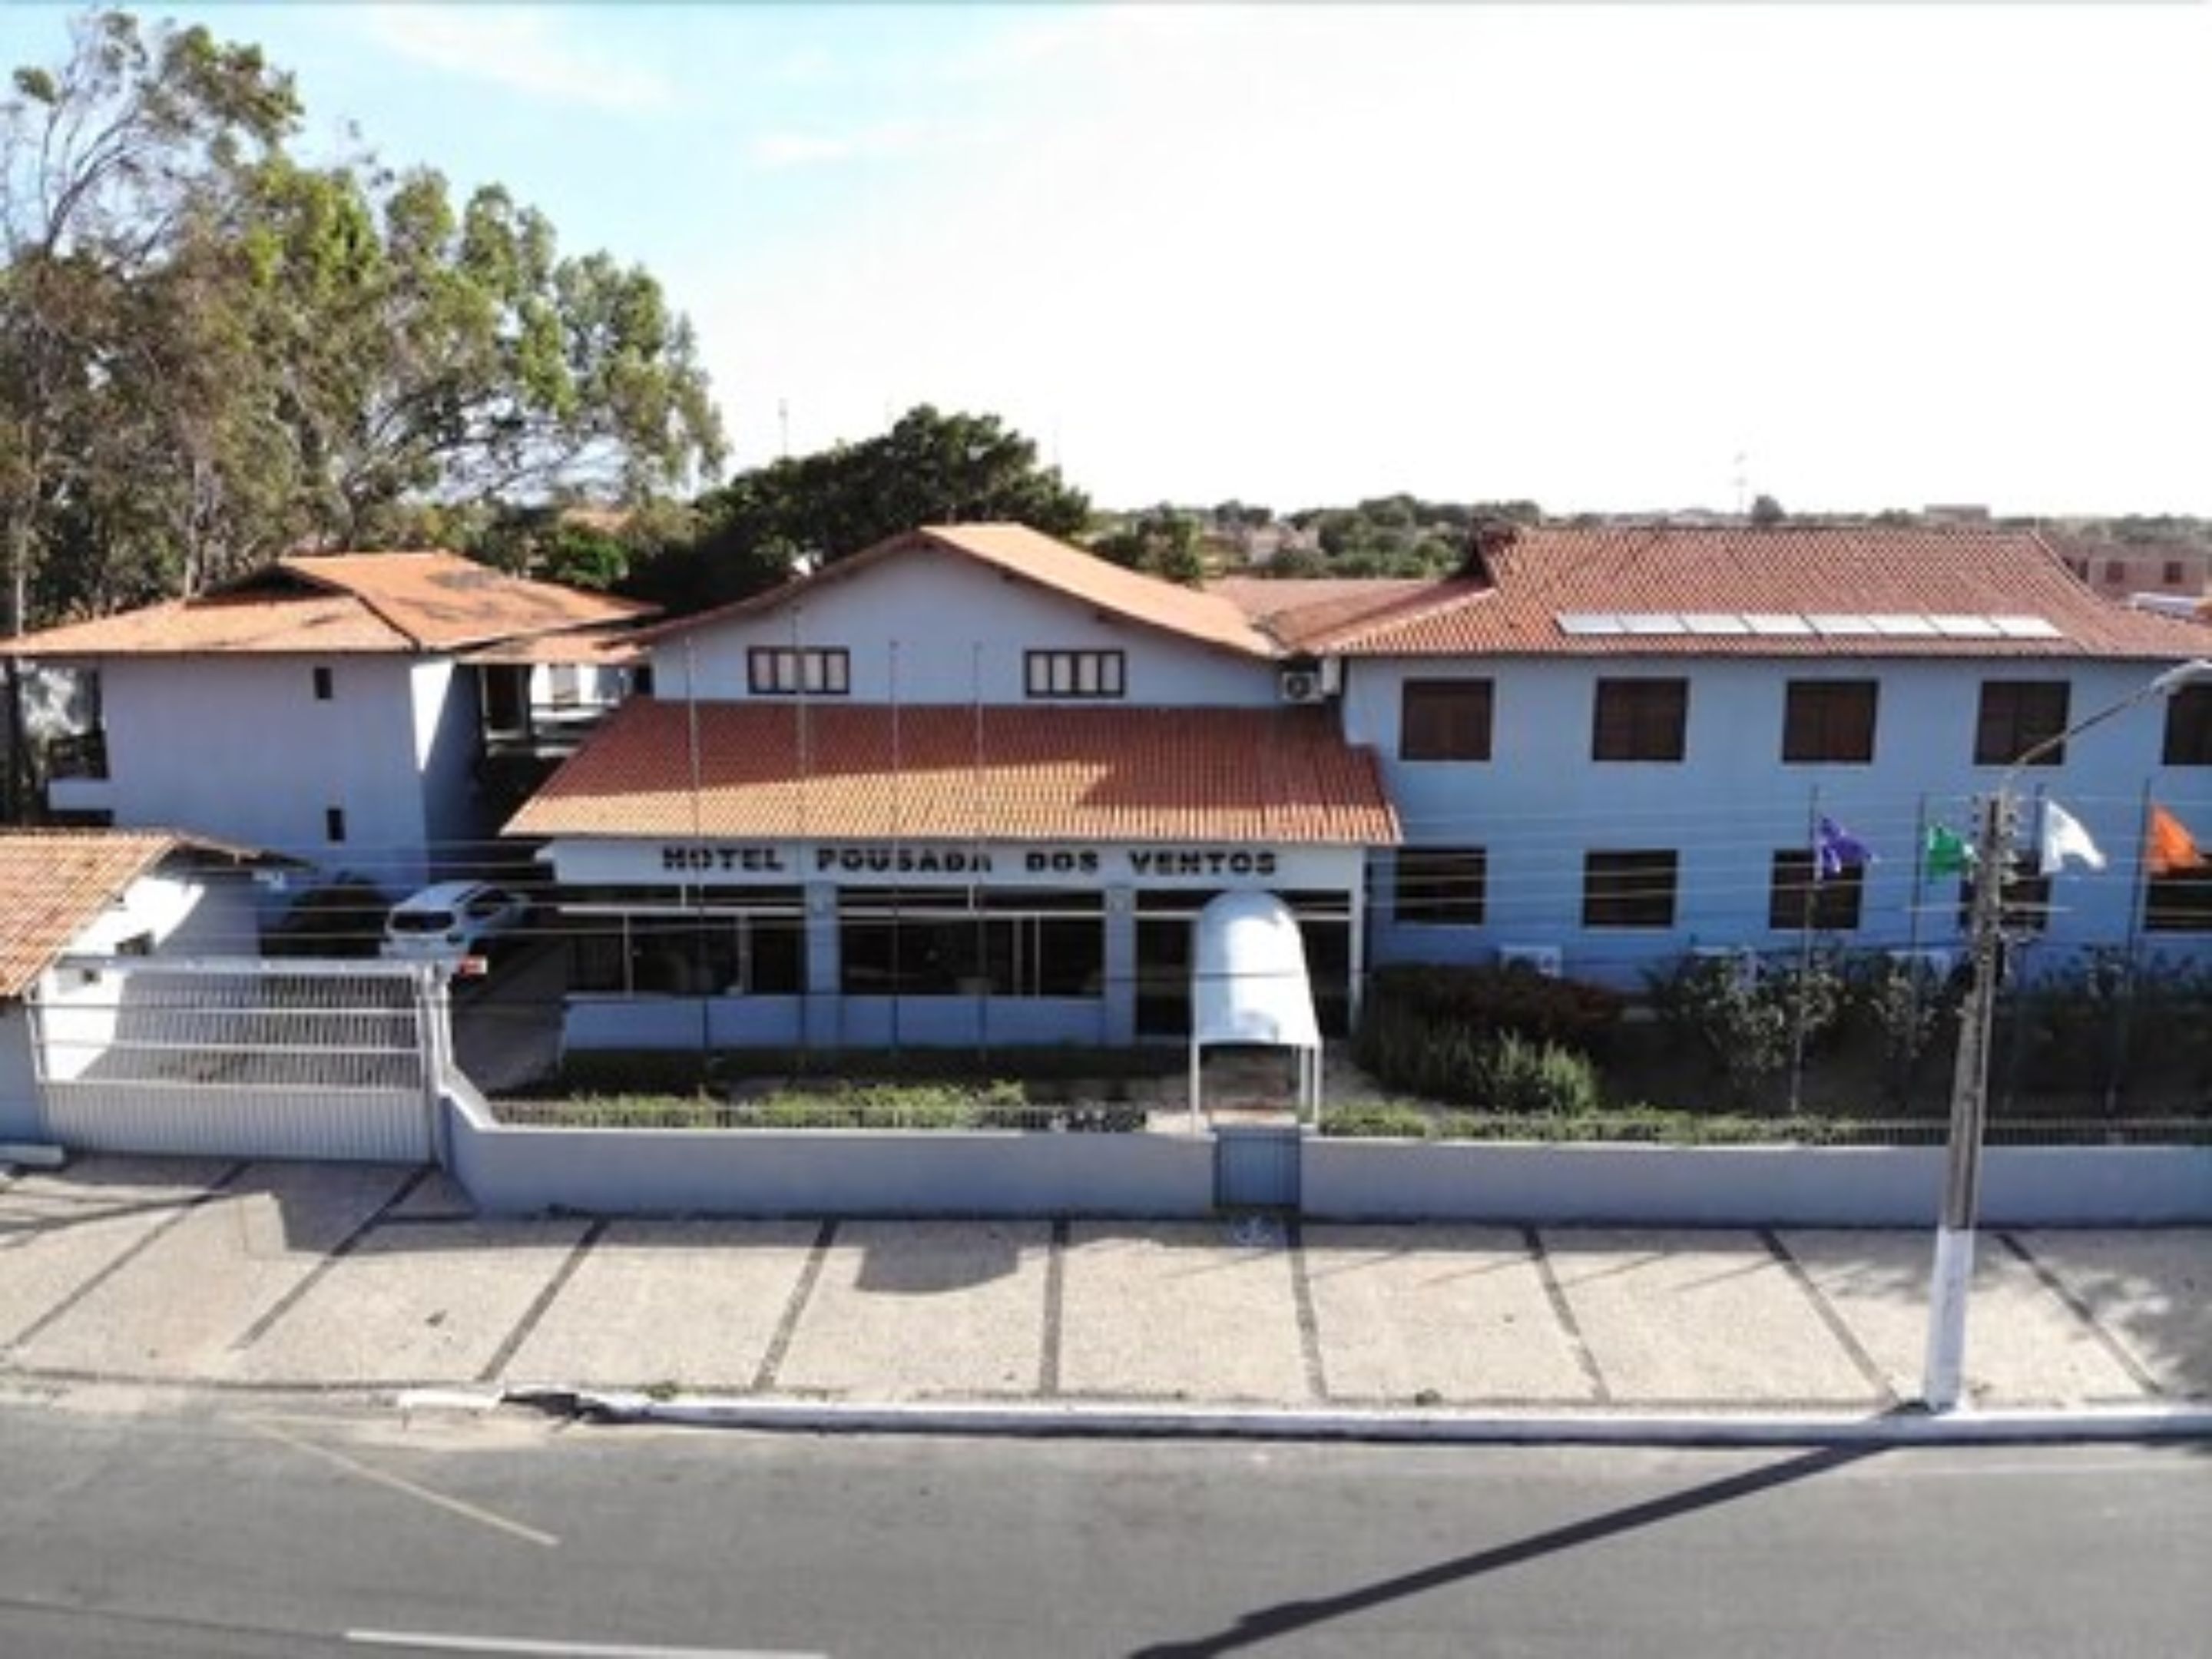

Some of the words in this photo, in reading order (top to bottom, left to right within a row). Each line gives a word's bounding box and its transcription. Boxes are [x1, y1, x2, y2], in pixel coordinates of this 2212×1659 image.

[663, 847, 784, 872] HOTEL
[1025, 851, 1099, 874] DOS
[1128, 850, 1277, 875] VENTOS
